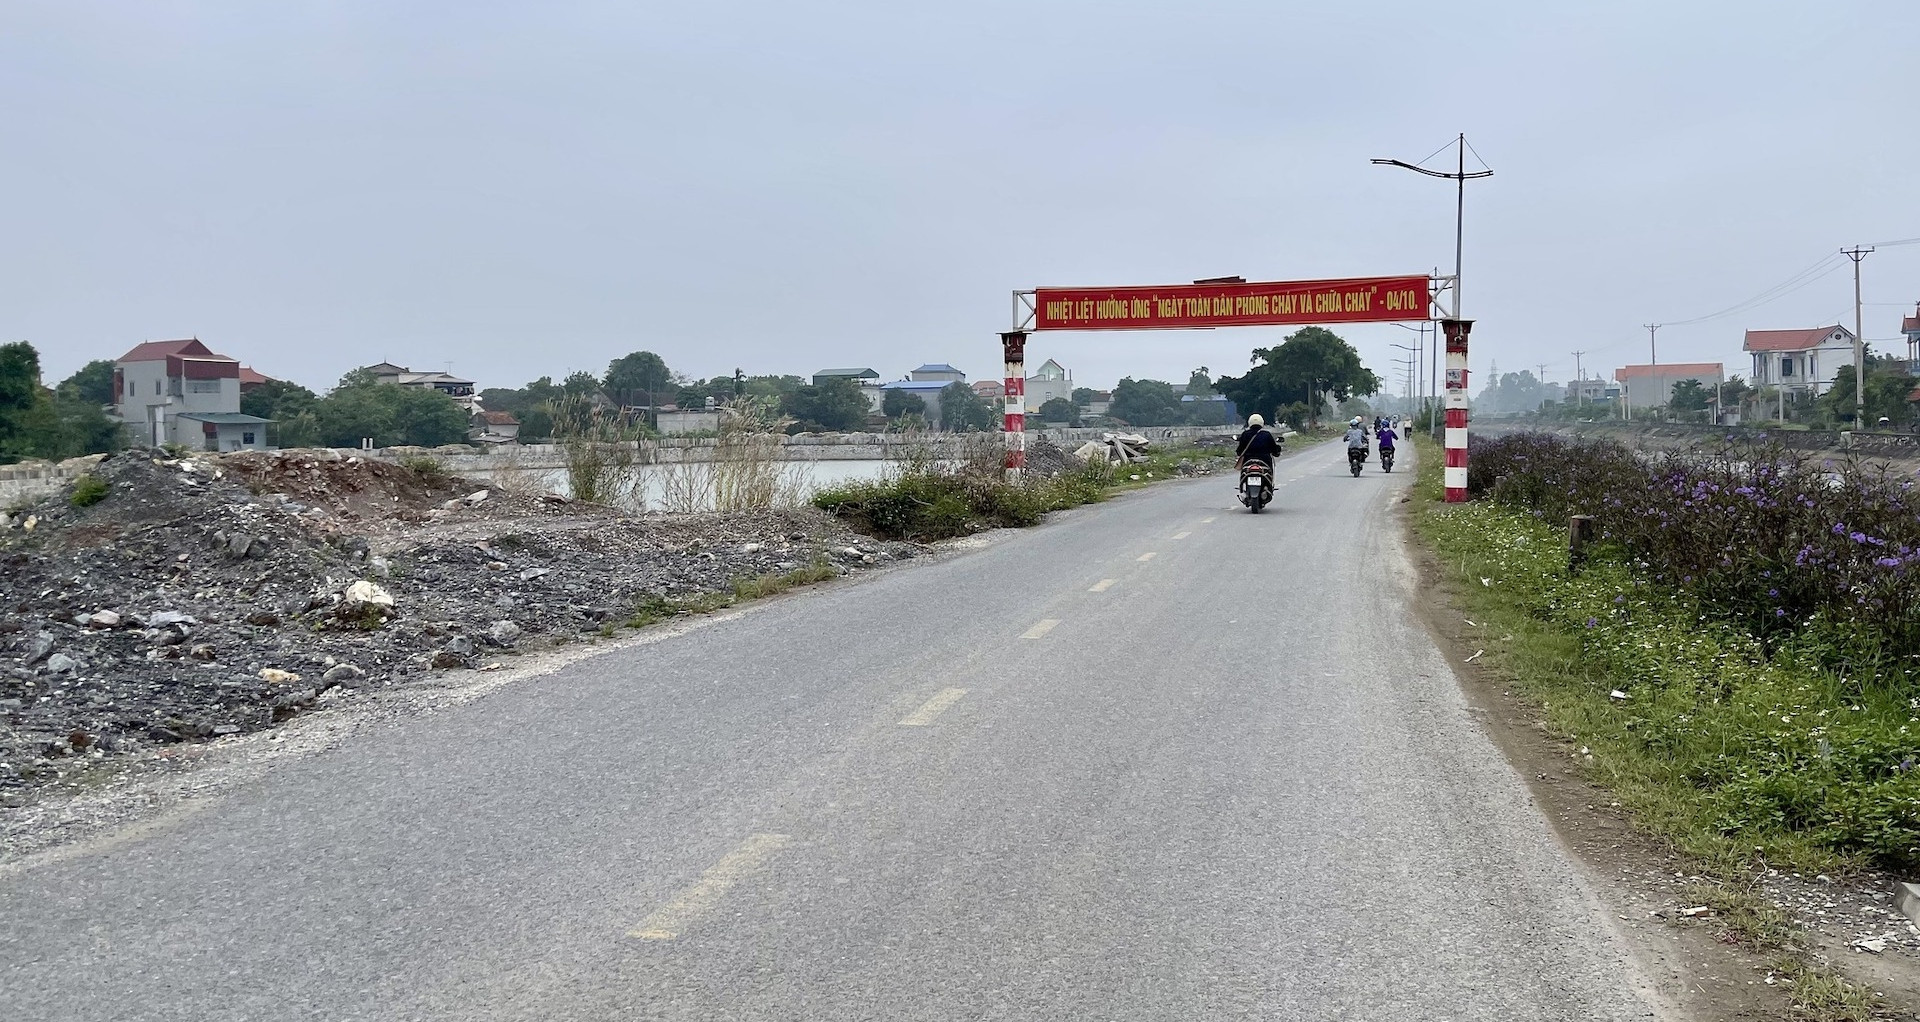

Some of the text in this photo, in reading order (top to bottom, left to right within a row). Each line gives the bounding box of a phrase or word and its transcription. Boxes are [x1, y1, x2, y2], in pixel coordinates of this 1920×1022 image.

[1047, 298, 1073, 323] NHIỆT
[1076, 297, 1094, 323] LIỆT
[1097, 294, 1128, 319] HƯỞNG
[1131, 296, 1150, 318] ỨNG
[1185, 294, 1210, 317] TOÀN
[1214, 293, 1233, 317] DÂN
[1236, 292, 1268, 315] PHÒNG
[1272, 291, 1297, 314] CHÁY
[1300, 290, 1313, 313] VÀ
[1315, 289, 1342, 313] CHỮA
[1386, 290, 1417, 311] 04/10.
